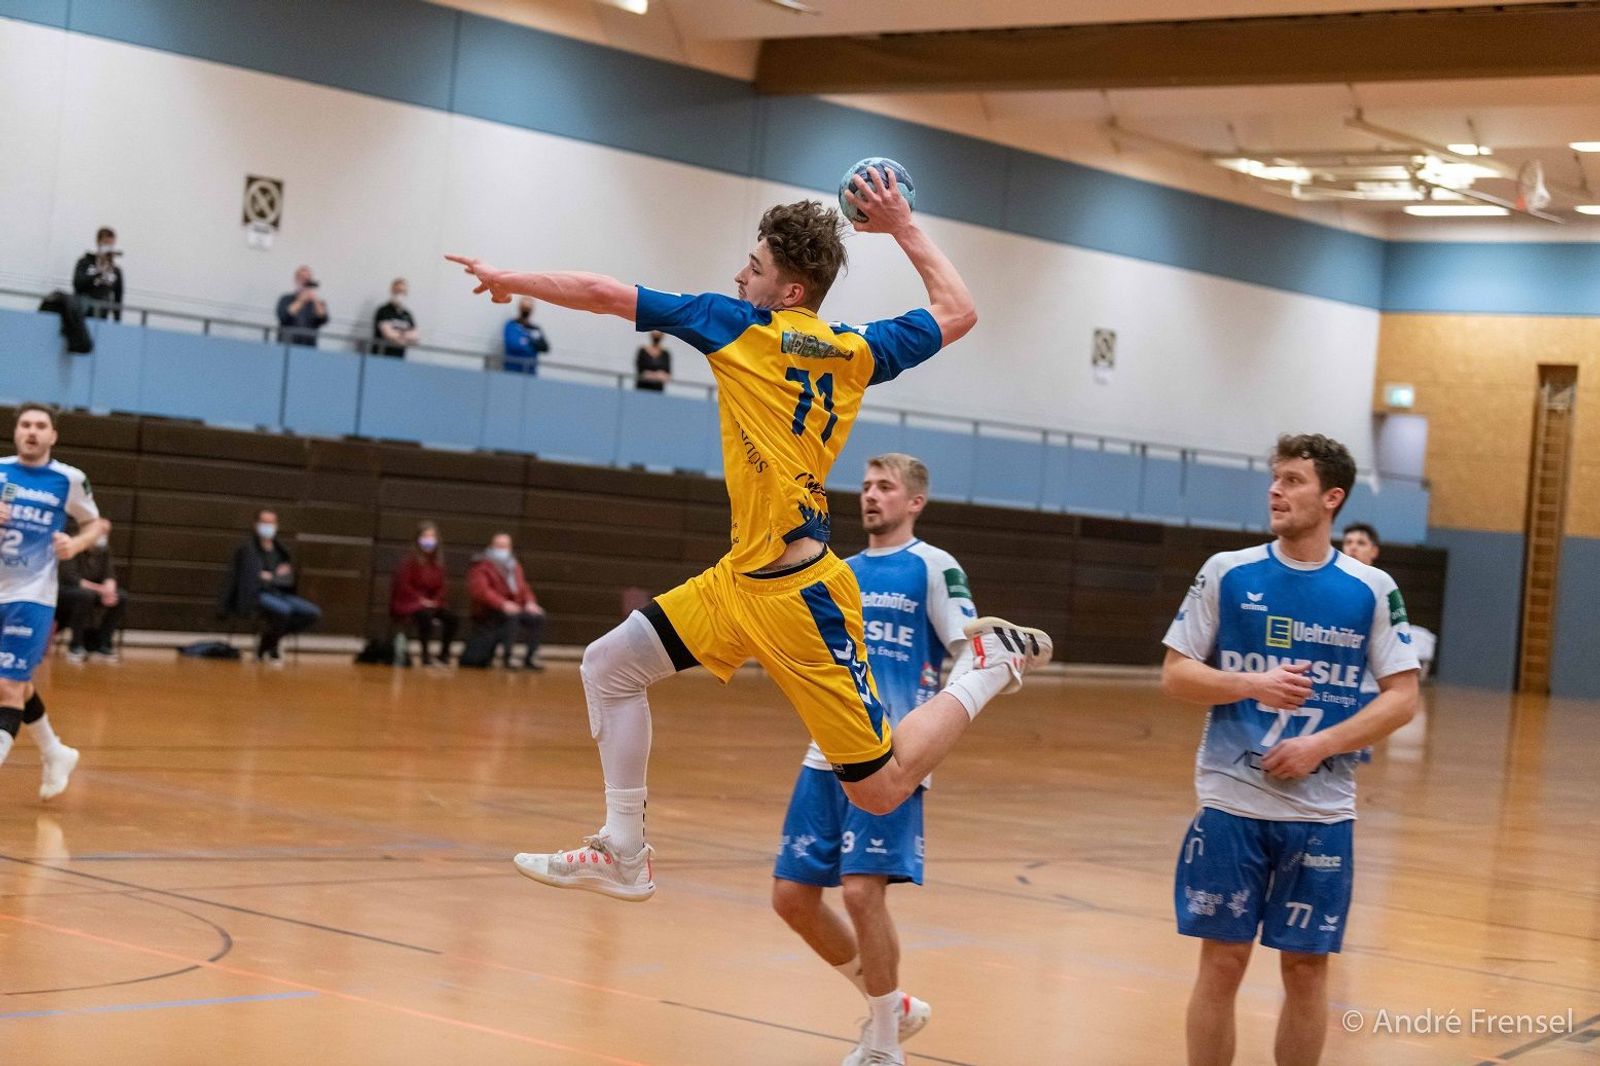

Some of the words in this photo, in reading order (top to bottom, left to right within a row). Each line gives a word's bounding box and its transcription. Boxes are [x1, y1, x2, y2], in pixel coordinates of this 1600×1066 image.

[784, 366, 838, 447] 71
[863, 620, 916, 647] SLE
[1256, 702, 1324, 748] 77
[1286, 901, 1313, 929] 77
